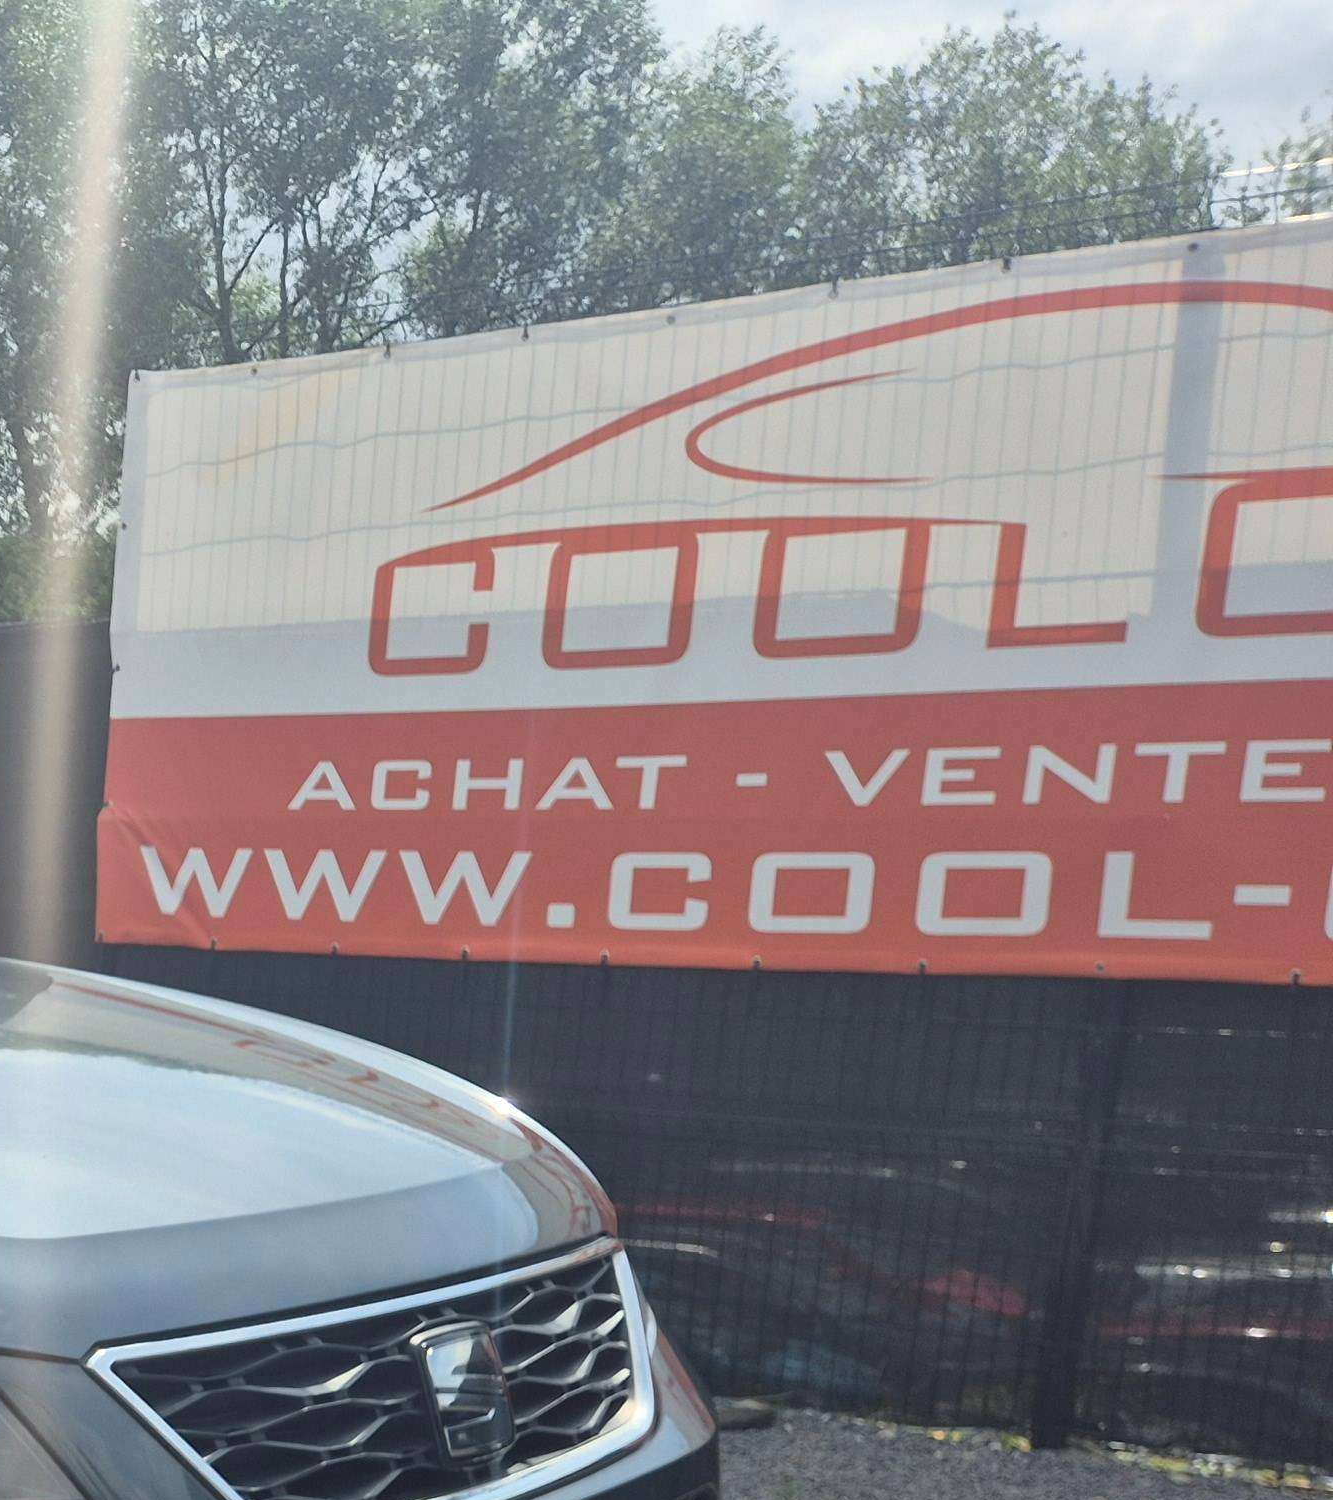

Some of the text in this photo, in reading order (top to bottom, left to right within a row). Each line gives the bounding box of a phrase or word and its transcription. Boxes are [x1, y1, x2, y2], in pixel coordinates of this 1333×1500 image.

[367, 516, 1129, 676] COOL
[287, 754, 689, 812] ACHAT
[824, 738, 1333, 808] VENTE
[138, 842, 1333, 941] WWW.COOL-
